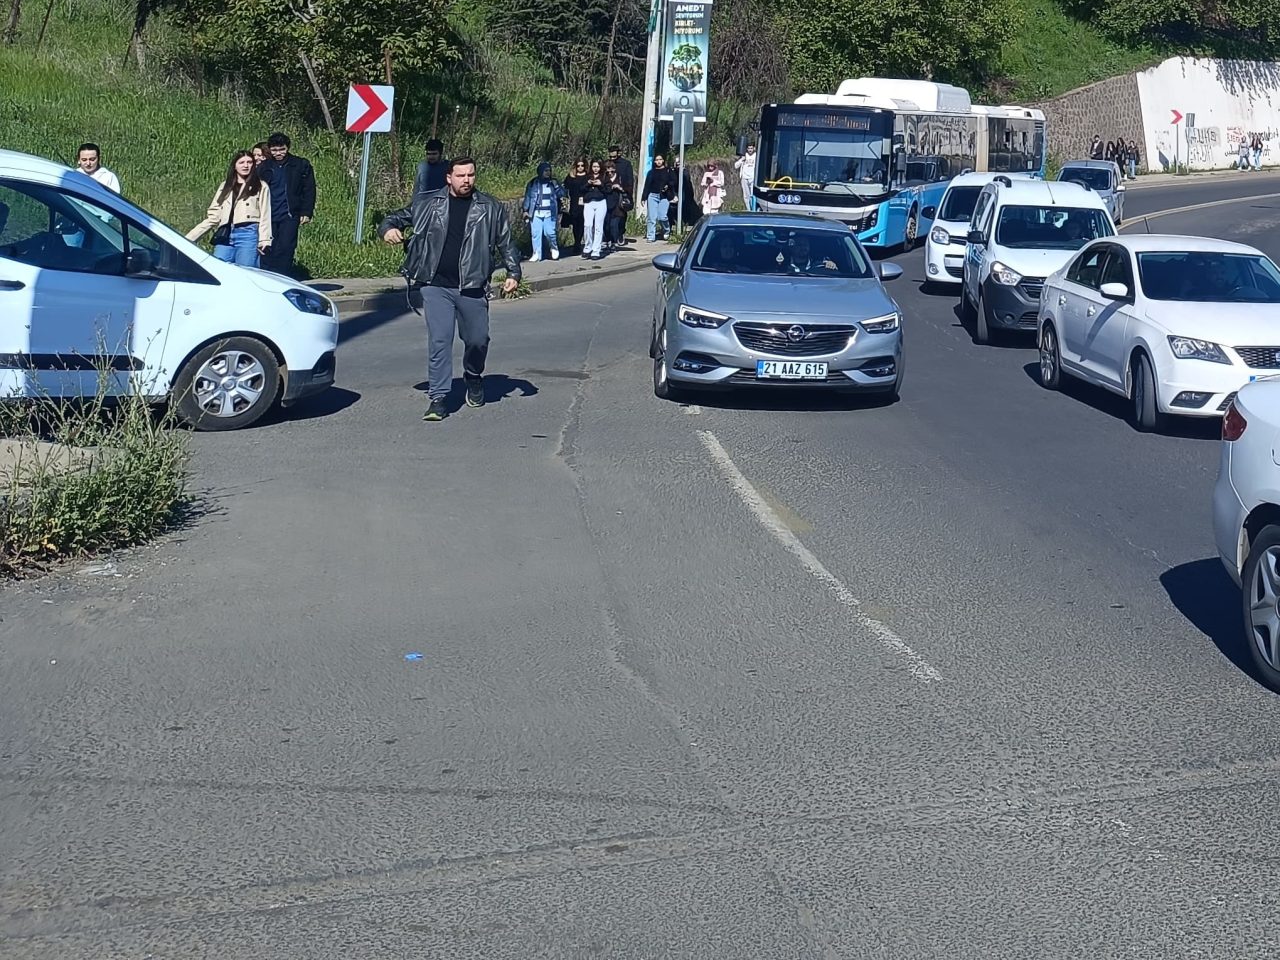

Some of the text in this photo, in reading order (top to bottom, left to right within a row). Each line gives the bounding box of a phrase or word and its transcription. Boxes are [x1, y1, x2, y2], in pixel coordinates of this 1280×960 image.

[764, 362, 824, 375] 21 AAZ 615
